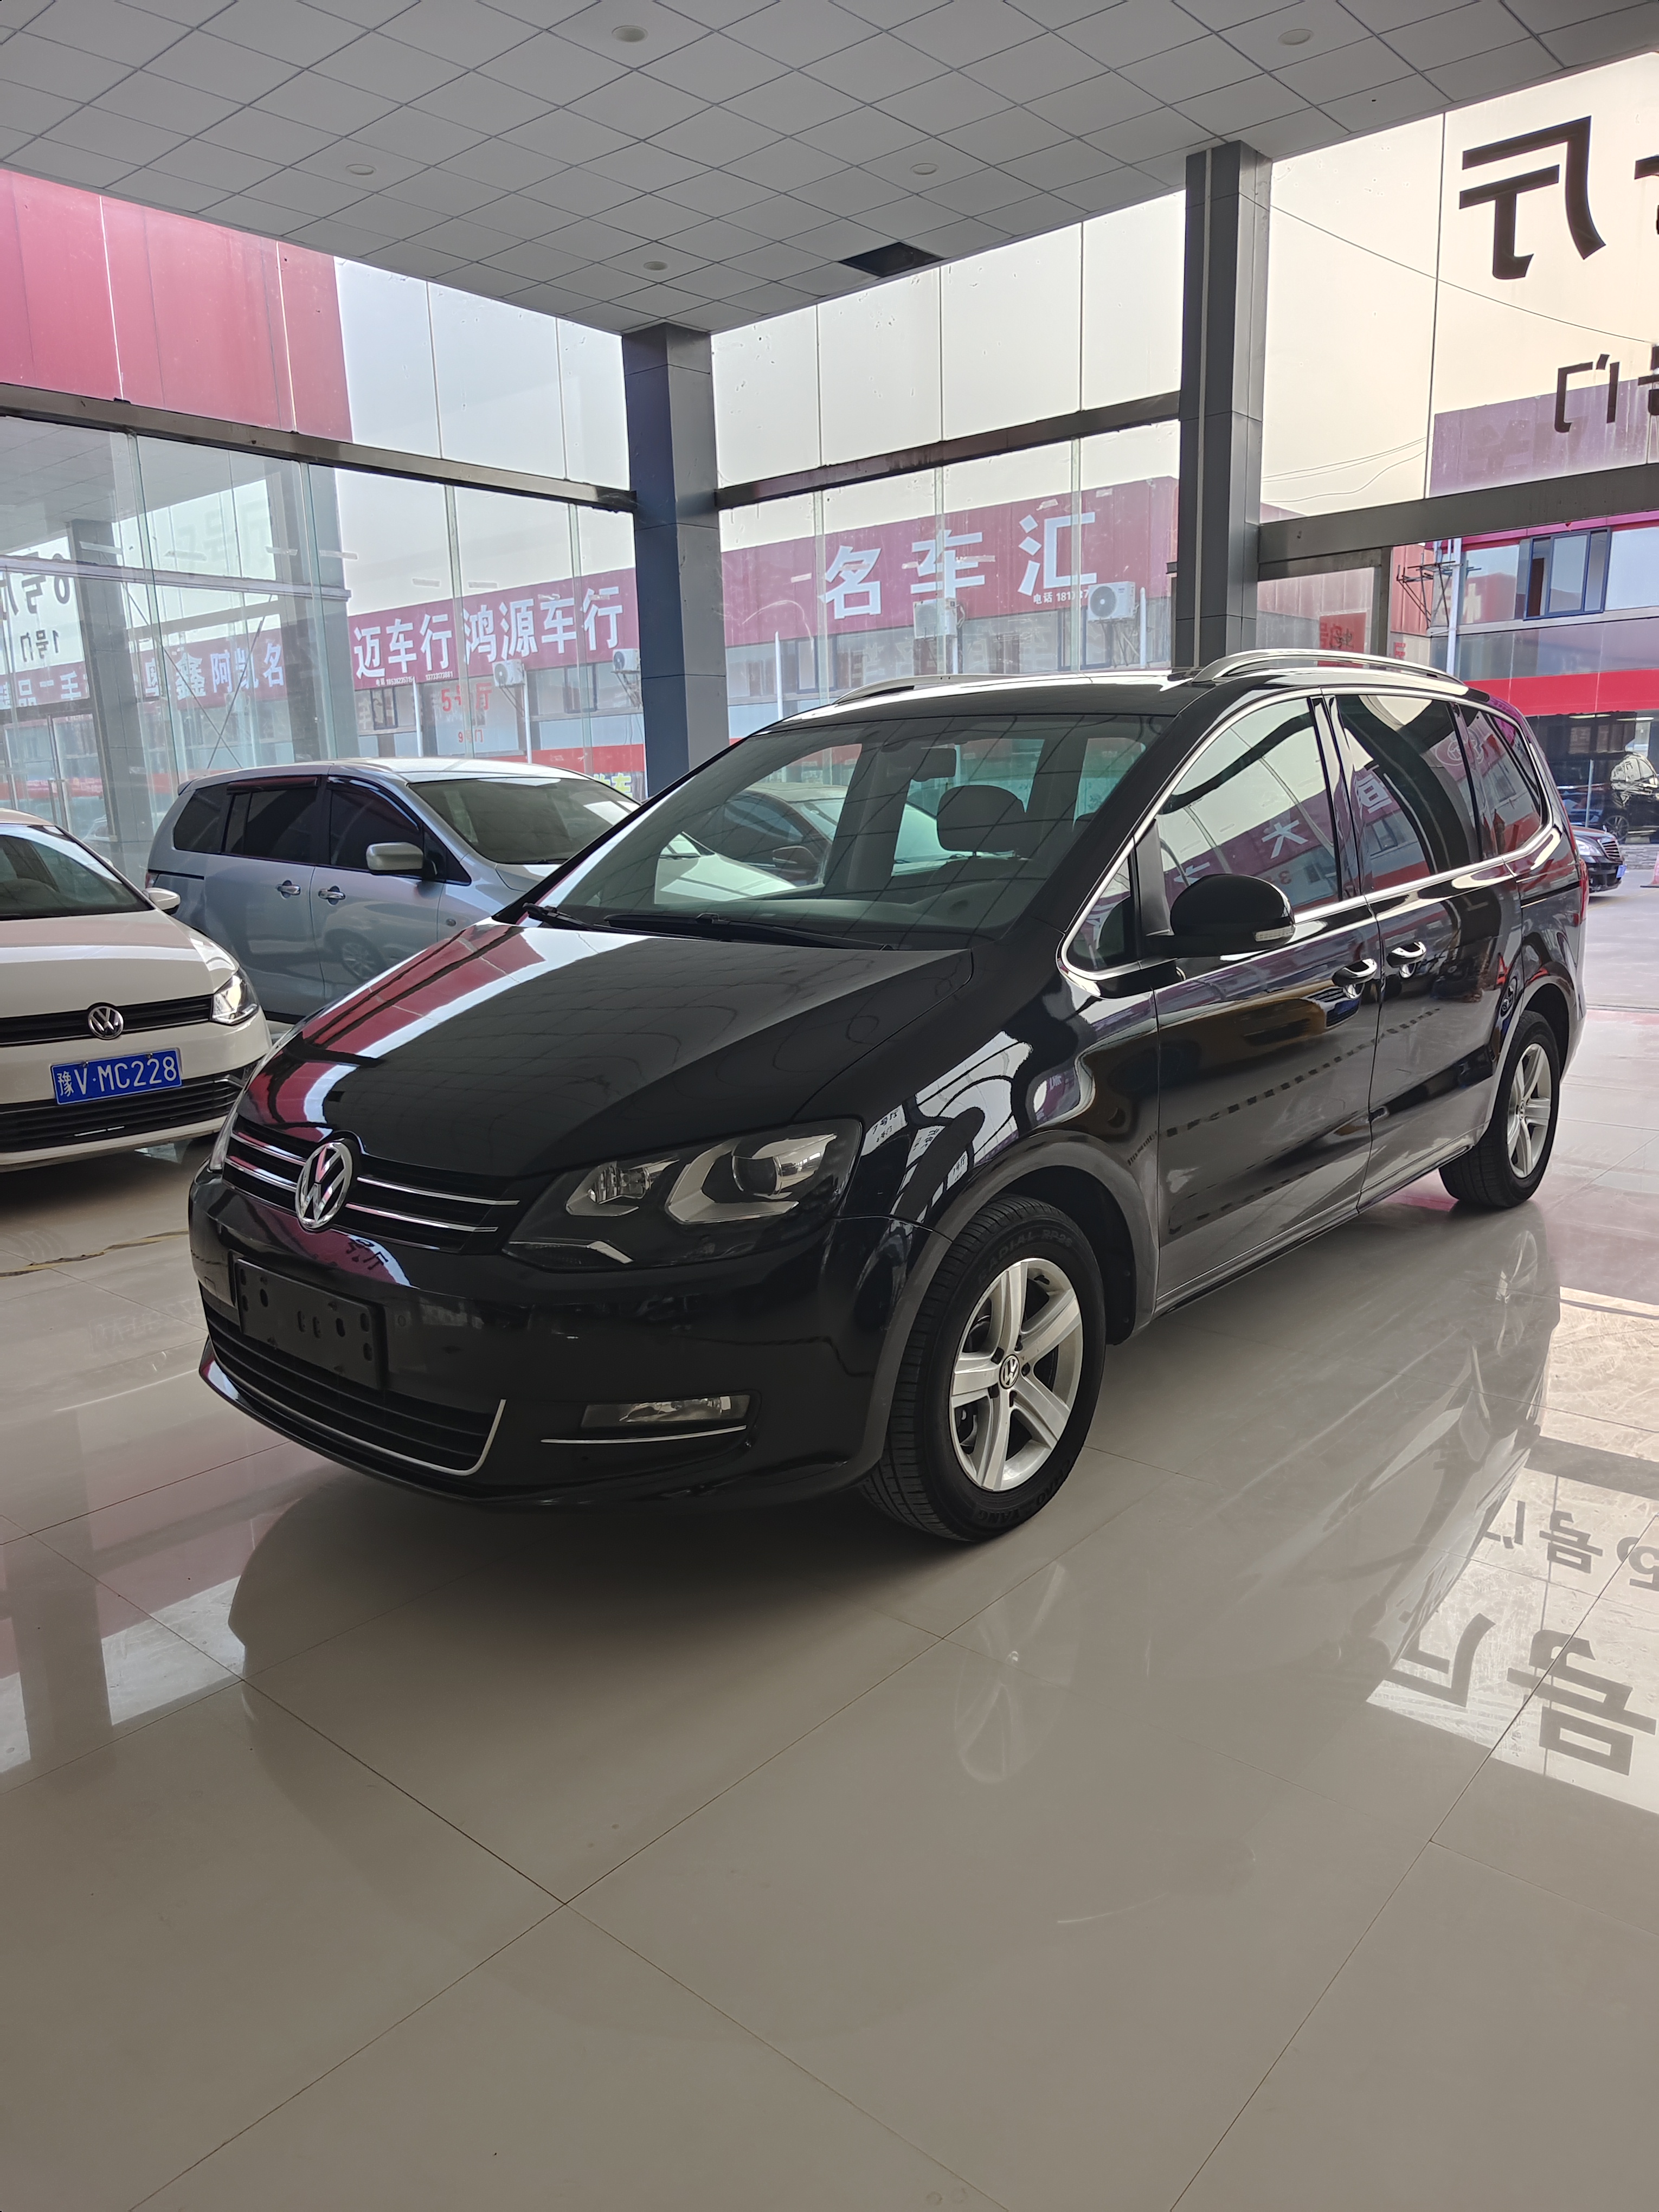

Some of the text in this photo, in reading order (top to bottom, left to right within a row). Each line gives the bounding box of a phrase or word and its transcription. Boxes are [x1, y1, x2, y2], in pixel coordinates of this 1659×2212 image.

[819, 511, 1098, 620] 名车汇
[1033, 591, 1053, 605] 电话
[354, 613, 453, 679] 迈车行
[462, 586, 623, 665] 鸿源车行
